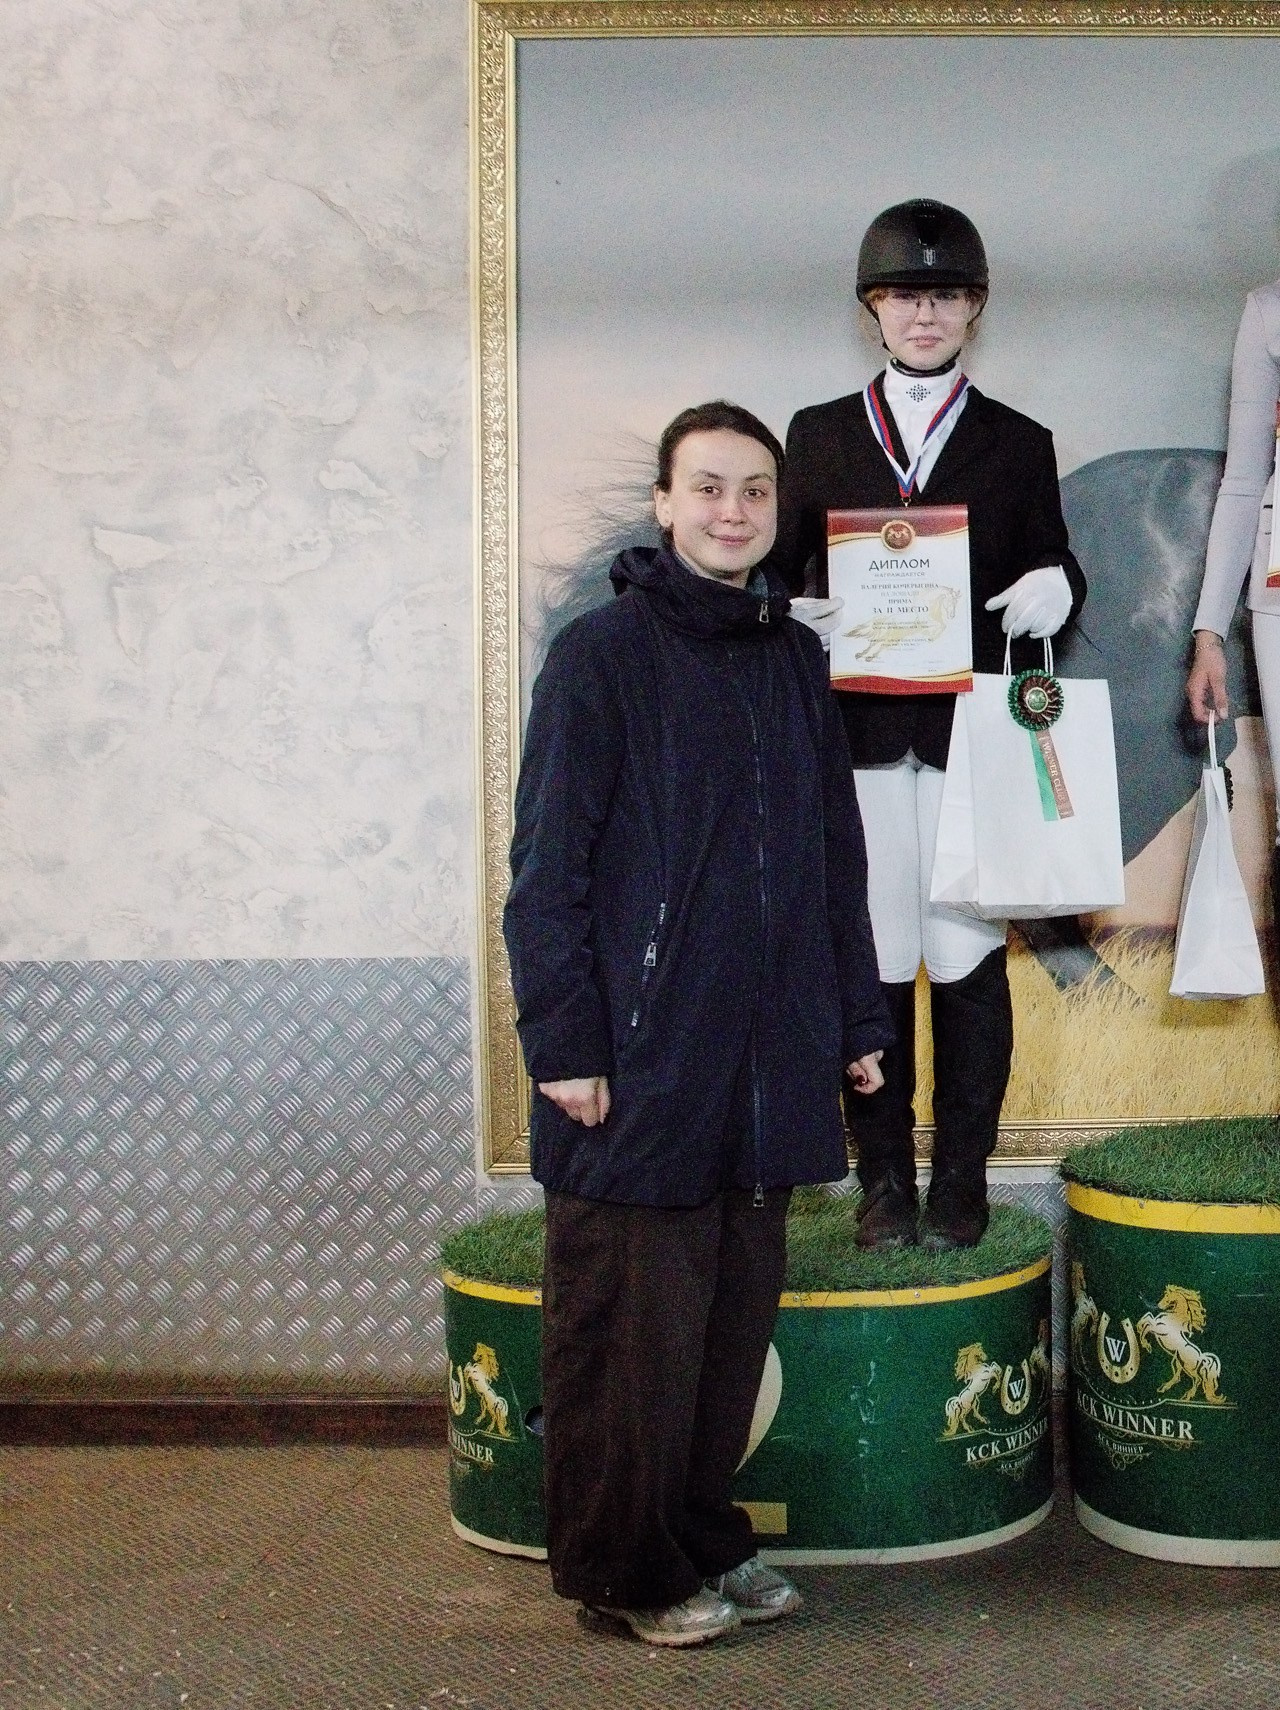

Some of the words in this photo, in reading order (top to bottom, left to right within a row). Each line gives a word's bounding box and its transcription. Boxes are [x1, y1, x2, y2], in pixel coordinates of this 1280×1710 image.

[868, 559, 930, 571] ДИПЛОМ
[898, 605, 929, 613] МЕСТО
[1105, 1336, 1127, 1363] W
[1009, 1378, 1025, 1399] W
[1103, 1404, 1195, 1440] WINNER
